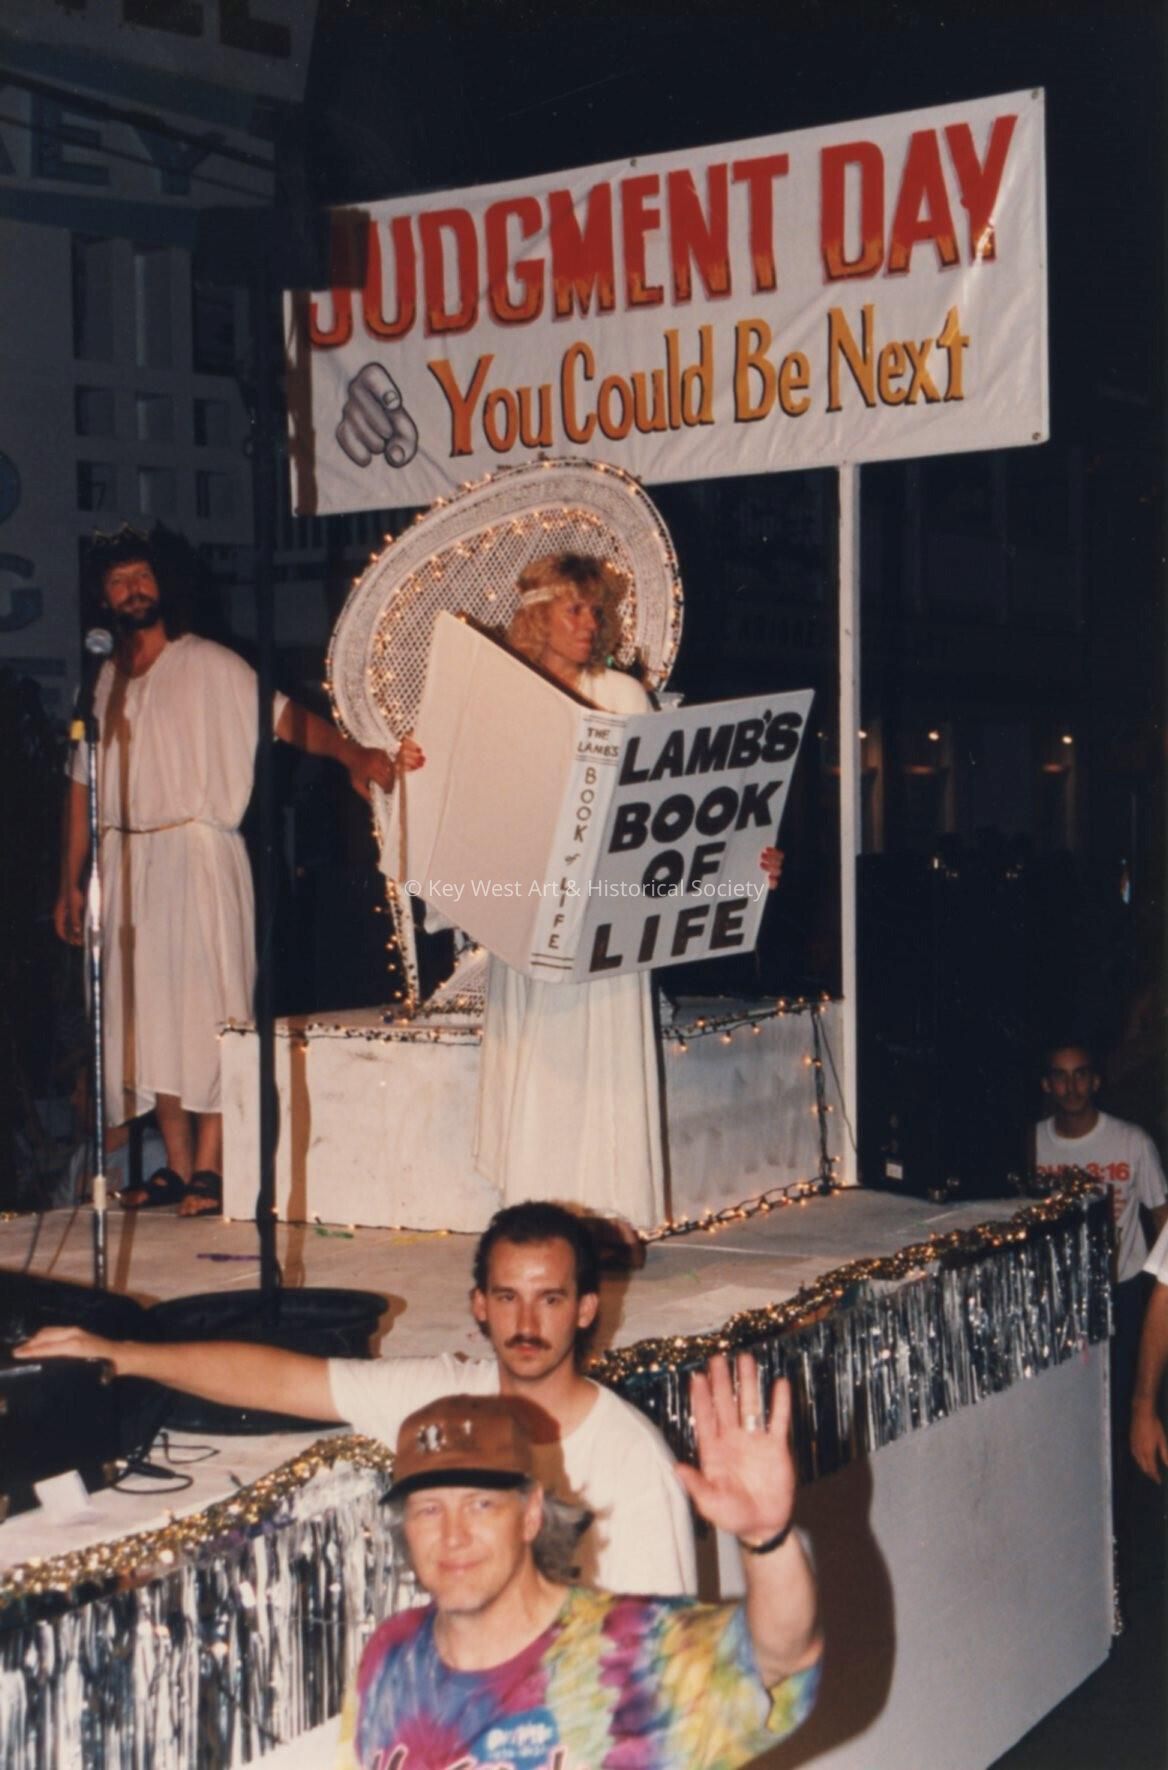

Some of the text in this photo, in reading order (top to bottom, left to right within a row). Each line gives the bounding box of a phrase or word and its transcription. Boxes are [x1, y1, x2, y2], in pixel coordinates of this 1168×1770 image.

[309, 114, 1018, 349] JUDGMENT DAY
[427, 304, 971, 457] You Could Be Next
[618, 709, 803, 786] LAMB'S
[608, 780, 783, 853] BOOK
[642, 841, 726, 898] OF
[589, 897, 749, 973] LIFE
